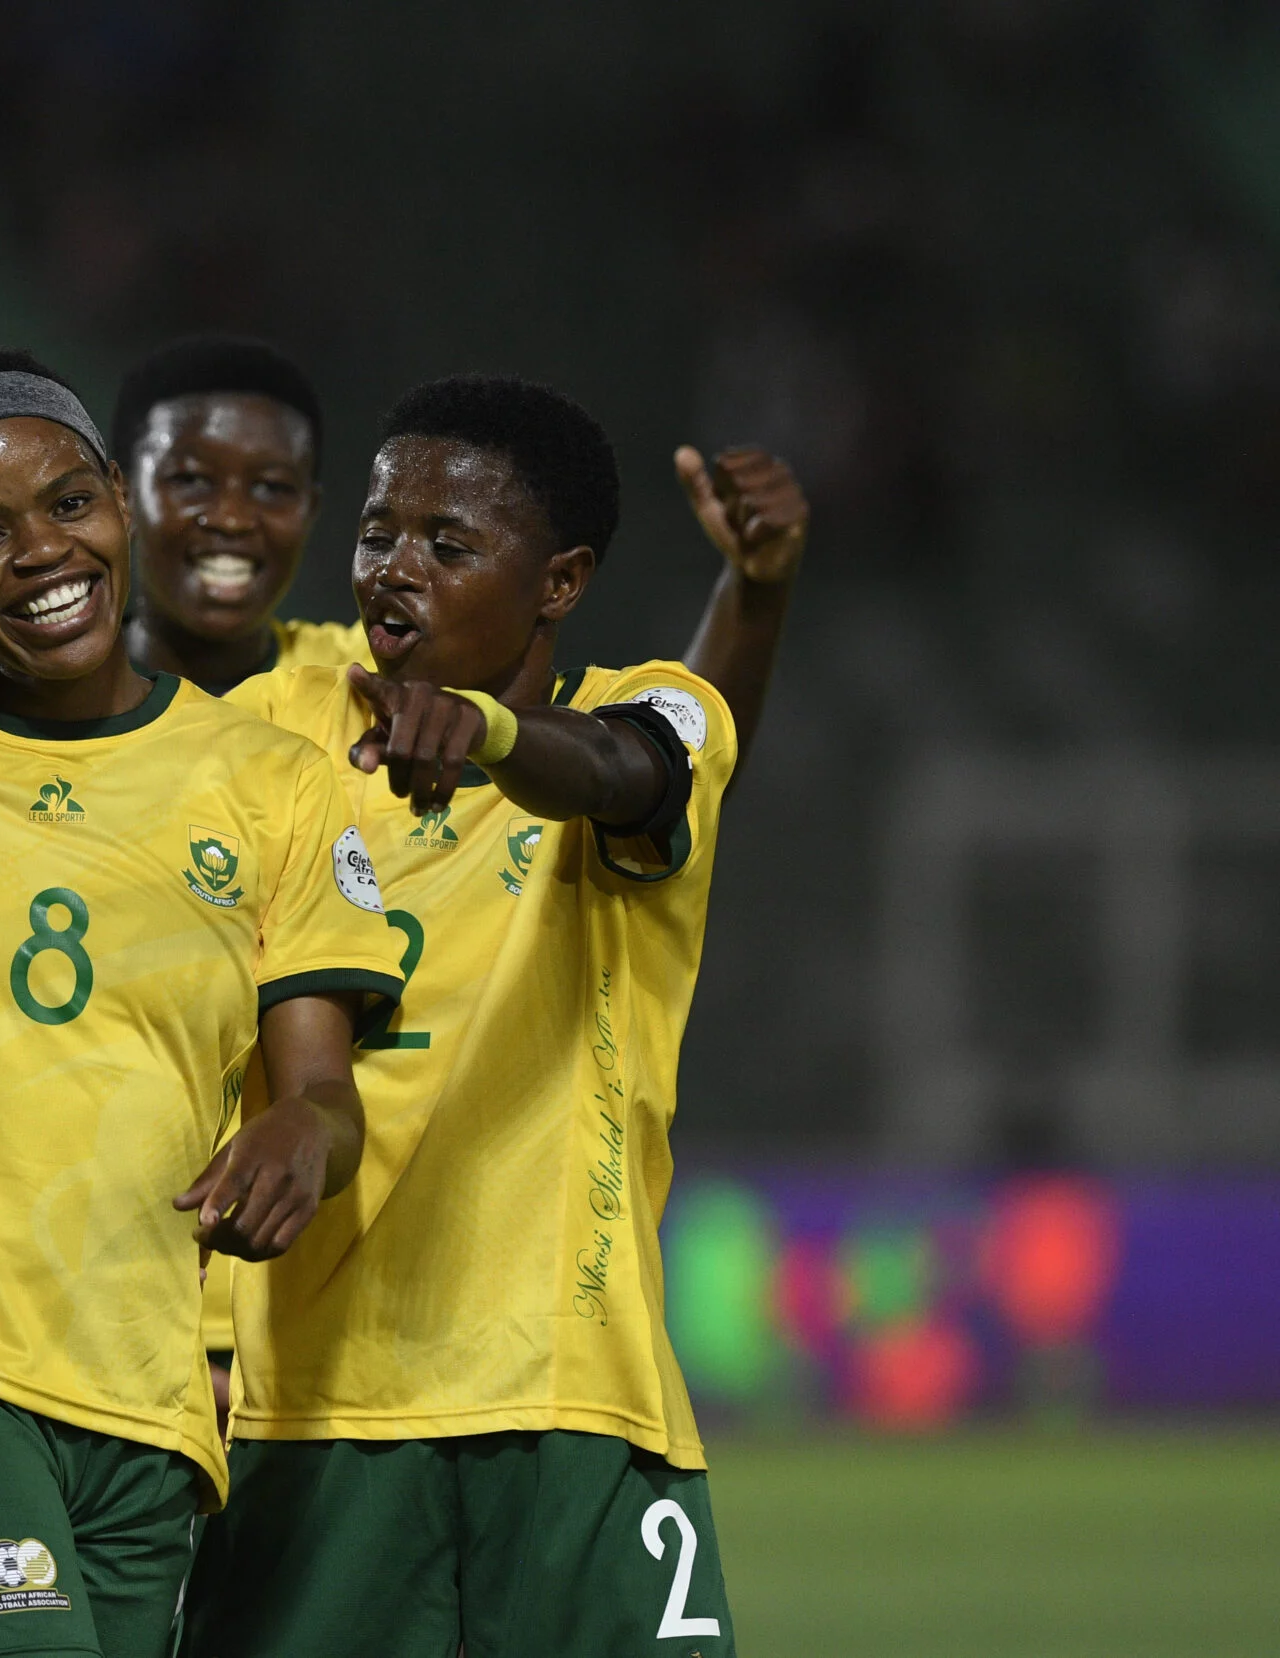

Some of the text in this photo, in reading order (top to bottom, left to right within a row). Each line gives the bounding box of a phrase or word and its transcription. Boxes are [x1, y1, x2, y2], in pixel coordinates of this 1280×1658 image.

[28, 812, 86, 822] LE COQ SPORTIF
[405, 837, 413, 845] LE
[430, 838, 459, 850] SPORTIF
[347, 850, 373, 868] Celeb
[354, 863, 375, 876] Afri
[357, 876, 377, 887] CA
[191, 884, 213, 902] SOUTH
[10, 887, 93, 1025] 8
[359, 909, 431, 1049] 2
[573, 1229, 613, 1326] Nkosi
[641, 1499, 720, 1639] 2
[1, 1591, 56, 1601] SOUTH AFRICAN
[28, 1599, 68, 1607] ASSOCIATION
